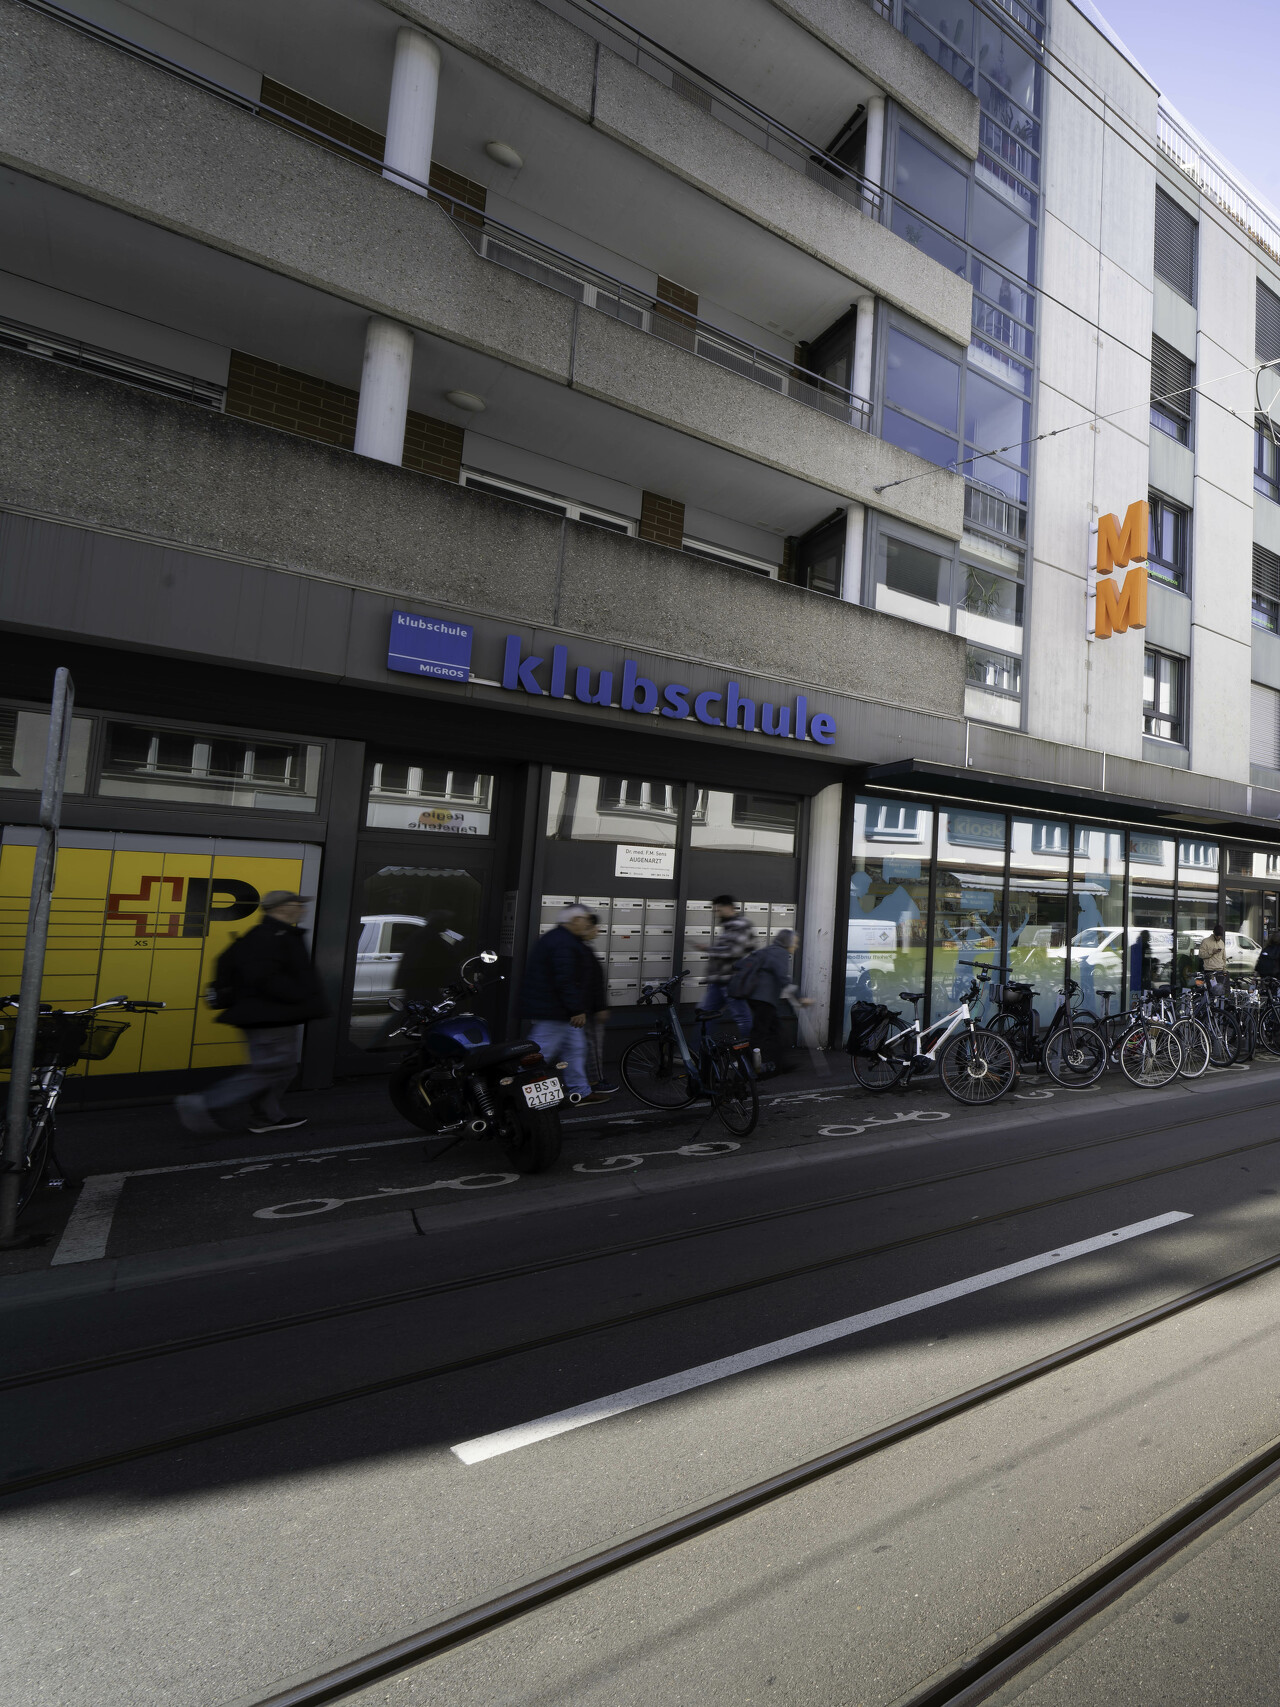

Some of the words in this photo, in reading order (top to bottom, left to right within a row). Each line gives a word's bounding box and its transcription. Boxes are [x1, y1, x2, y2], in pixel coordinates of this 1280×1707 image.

[397, 614, 468, 638] klubschule
[419, 663, 465, 678] MIGROS
[502, 634, 838, 745] klubschule
[953, 816, 1004, 838] kiosk
[629, 856, 663, 864] AUGENARZT
[534, 1081, 549, 1093] BS
[528, 1089, 560, 1106] 21737
